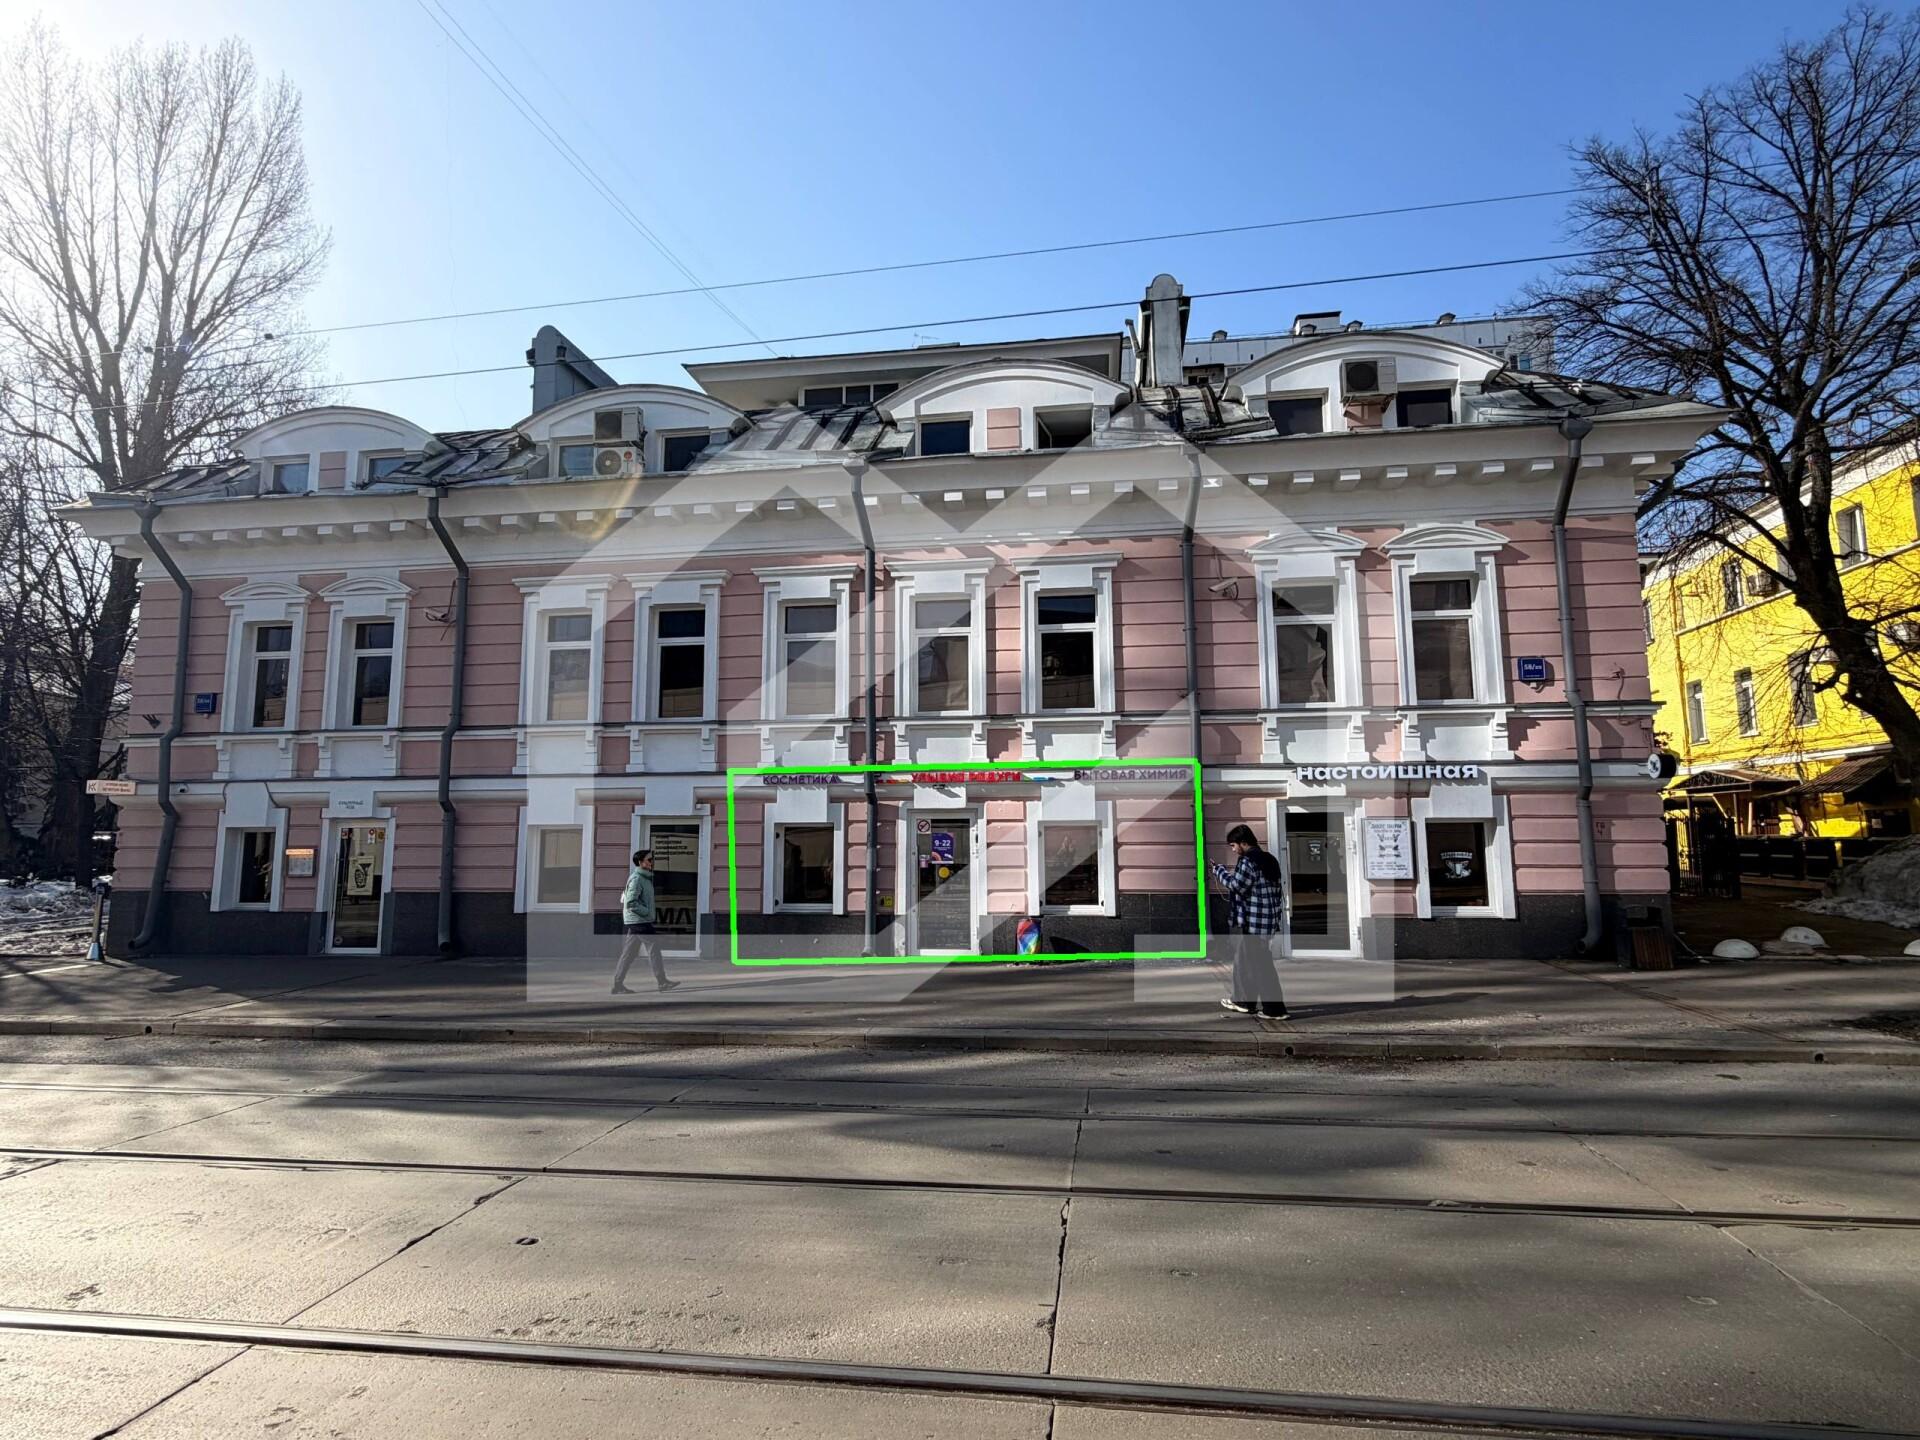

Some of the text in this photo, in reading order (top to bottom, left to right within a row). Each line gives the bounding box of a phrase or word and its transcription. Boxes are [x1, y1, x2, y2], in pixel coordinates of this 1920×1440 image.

[1074, 769, 1187, 780] БЫТОВАЯ ХИМИЯ
[1296, 764, 1480, 780] настоишная
[763, 776, 837, 786] КОСМЕТИКА
[934, 839, 951, 847] 9-22
